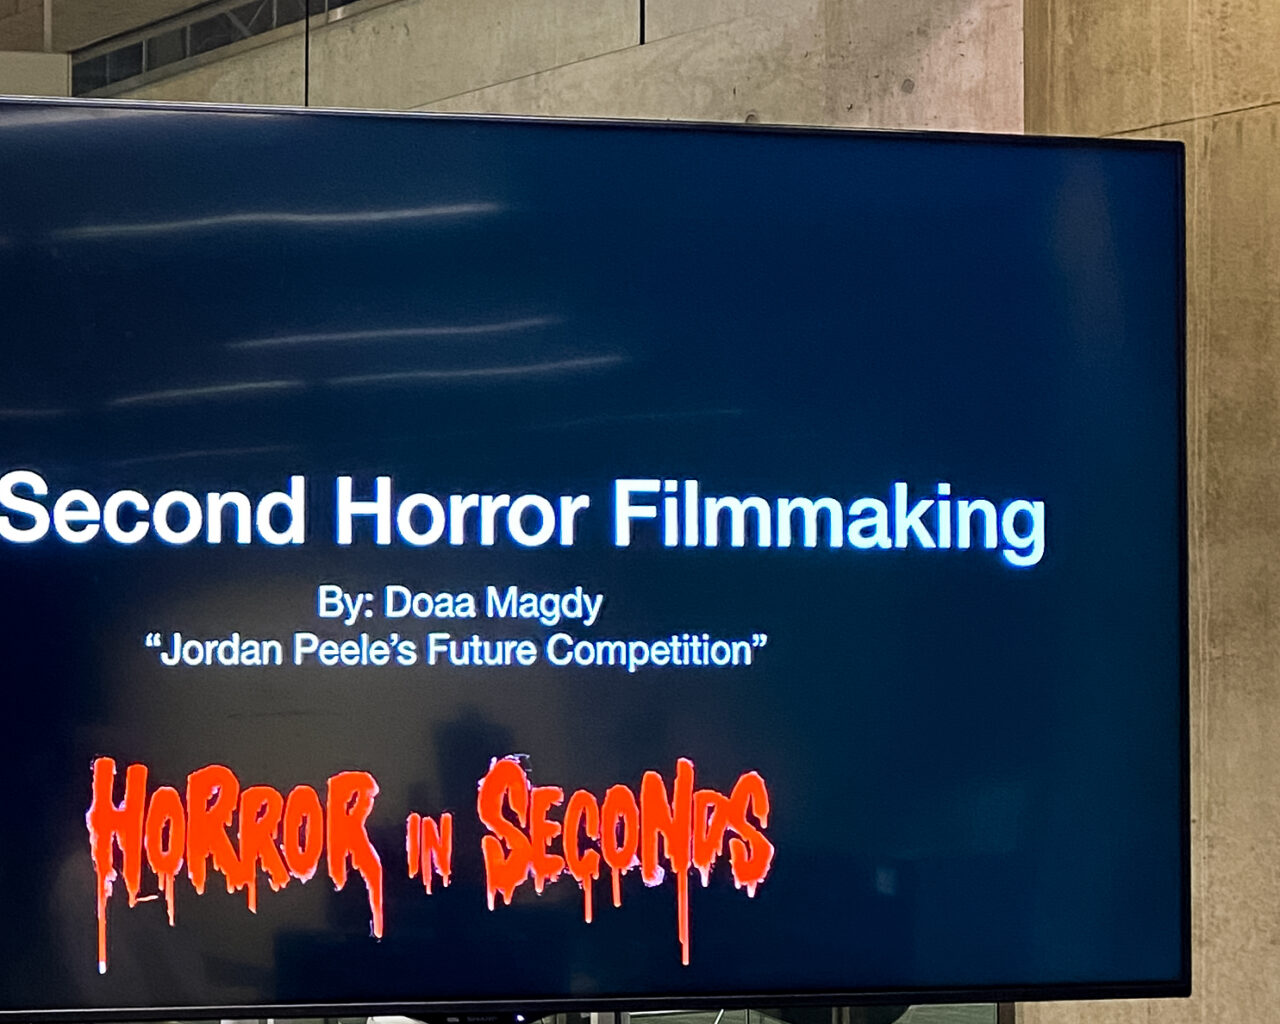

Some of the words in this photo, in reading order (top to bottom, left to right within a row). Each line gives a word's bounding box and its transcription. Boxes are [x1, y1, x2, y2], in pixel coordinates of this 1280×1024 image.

[336, 476, 590, 547] Horror
[614, 478, 1046, 568] Filmmaking
[317, 585, 375, 625] By:
[384, 585, 477, 619] Doaa
[485, 586, 604, 626] Magdy
[144, 631, 284, 666] “Jordan
[293, 631, 419, 666] Peele’s
[427, 632, 538, 666] Future
[545, 631, 768, 673] Competition”
[87, 756, 384, 974] HORROR
[477, 752, 775, 965] SECONDS
